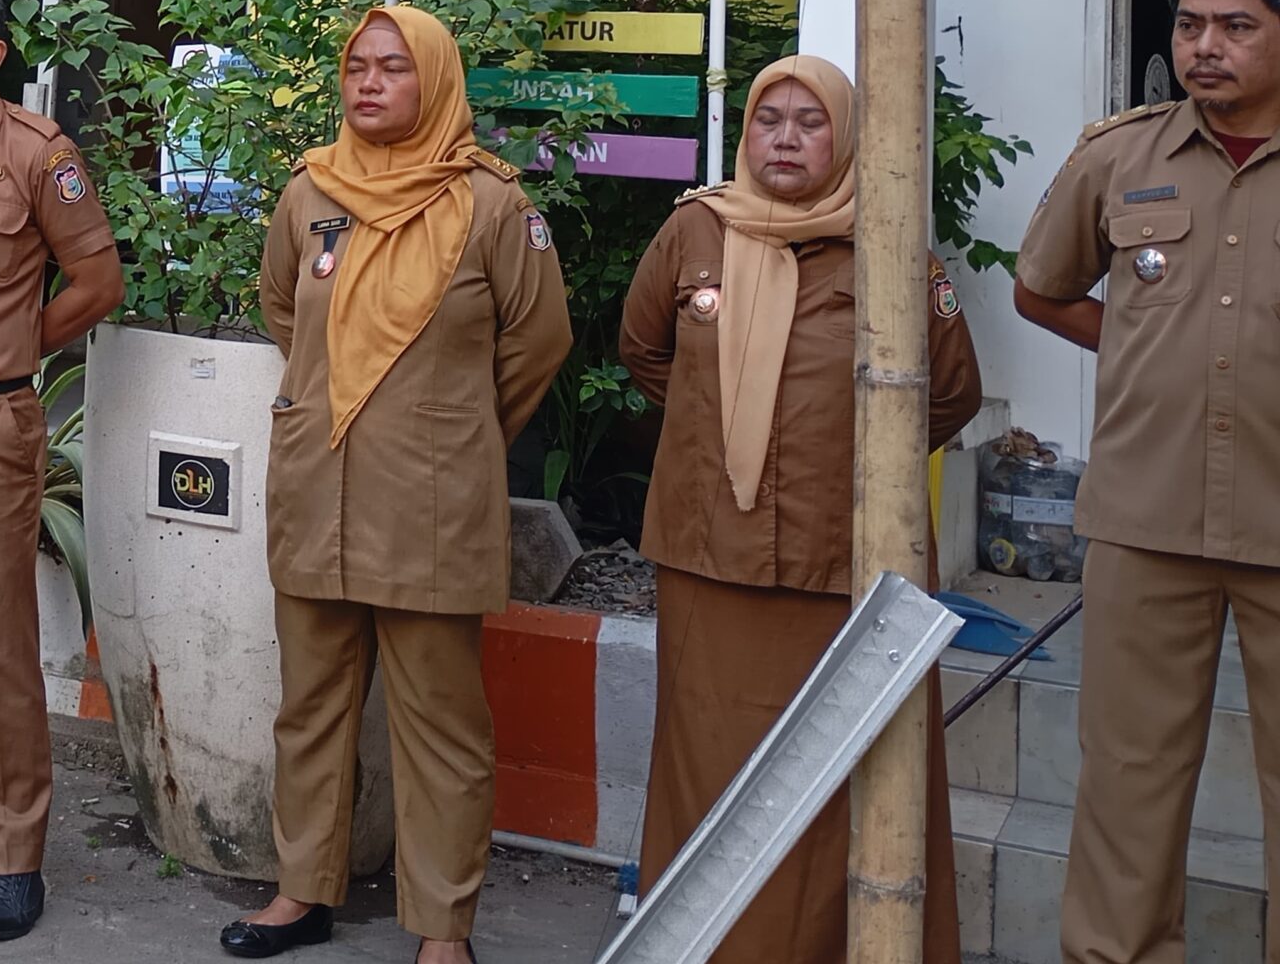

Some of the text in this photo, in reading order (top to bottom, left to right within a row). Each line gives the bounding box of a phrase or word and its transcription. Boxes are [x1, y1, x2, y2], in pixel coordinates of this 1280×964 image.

[503, 20, 614, 41] RATUR
[513, 79, 594, 102] INDAH
[175, 469, 211, 493] DLH
